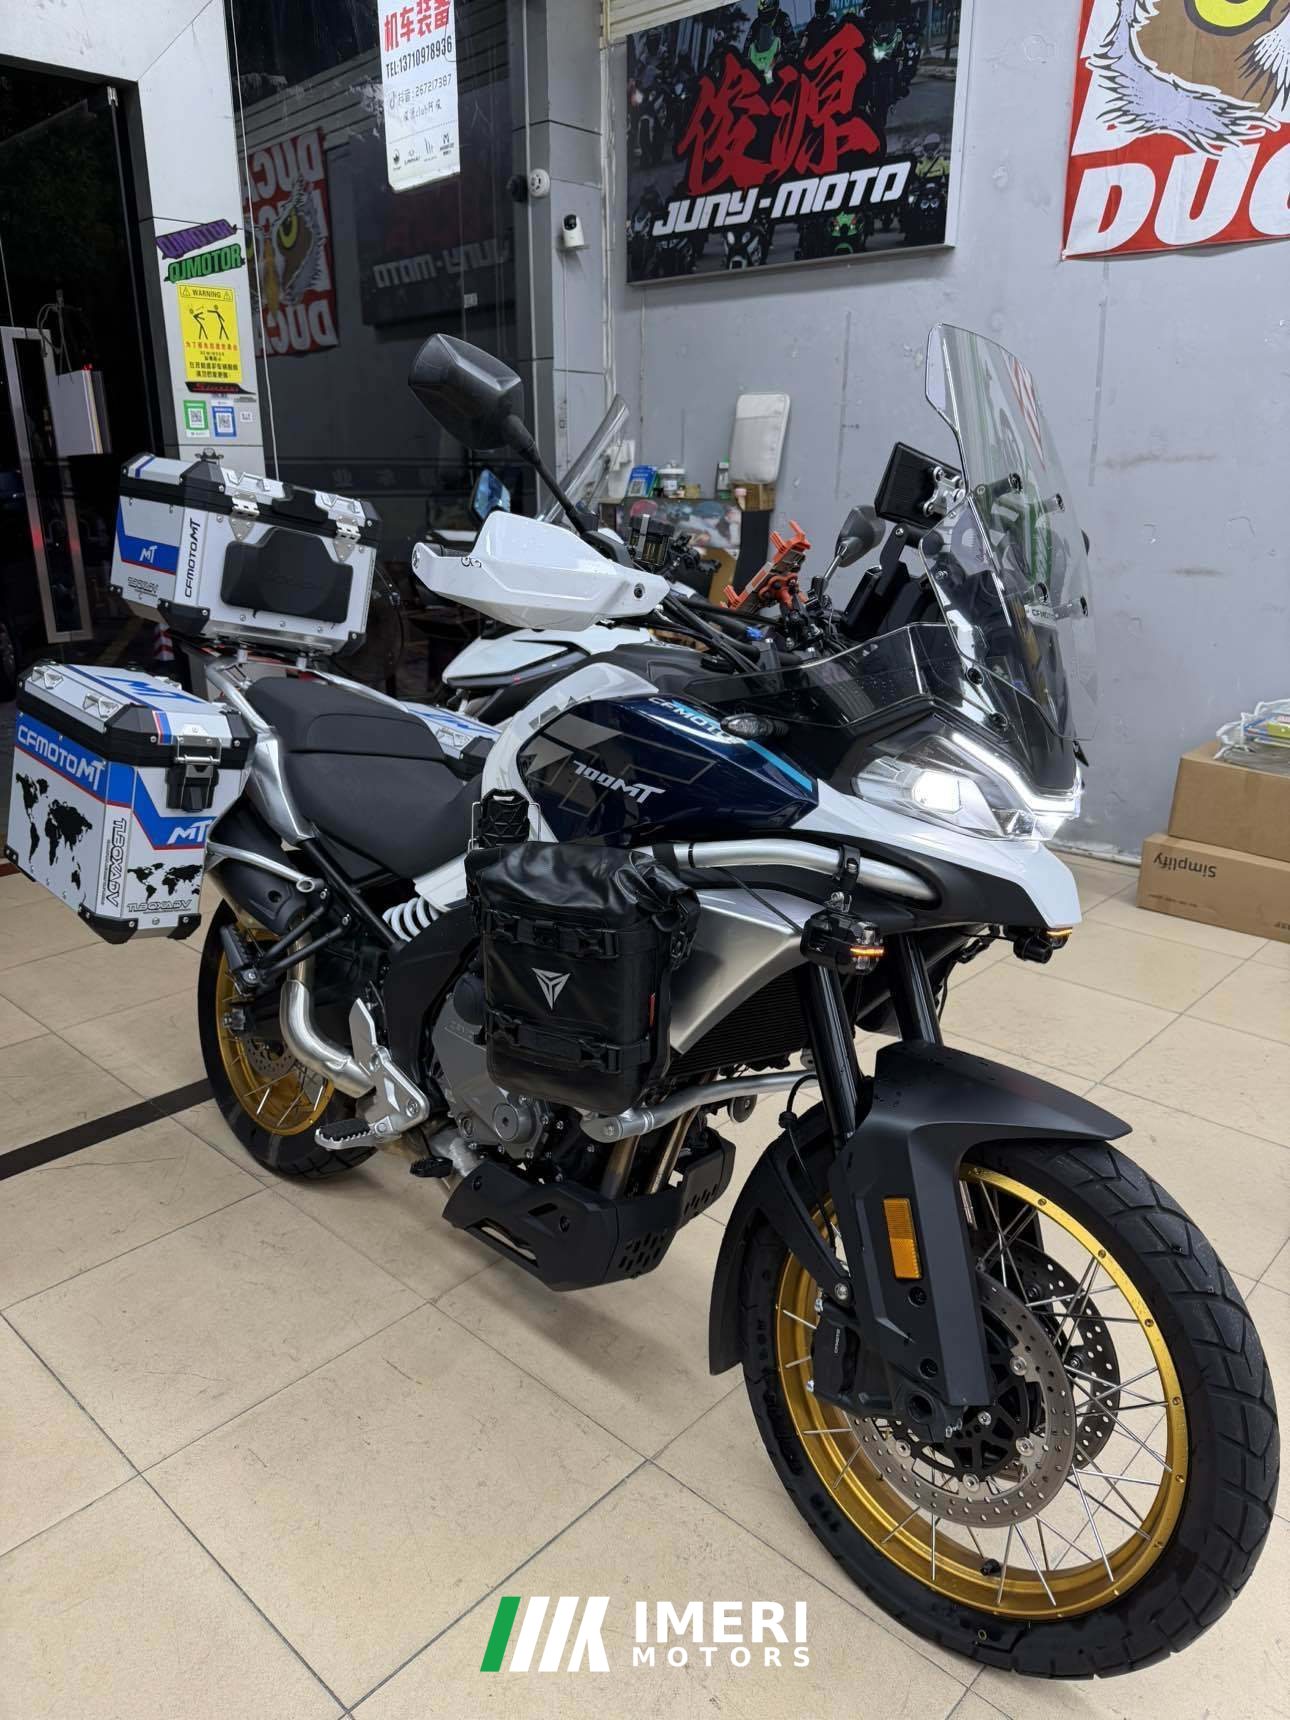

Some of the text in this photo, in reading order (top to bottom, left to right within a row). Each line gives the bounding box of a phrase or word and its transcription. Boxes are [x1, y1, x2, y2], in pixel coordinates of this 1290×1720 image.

[384, 0, 451, 52] 机车装备
[386, 35, 453, 78] TEL:13710978936
[677, 23, 880, 196] 俊源
[169, 245, 242, 282] QJMOTOR
[191, 288, 222, 299] WARNING
[139, 545, 158, 564] MT
[573, 760, 666, 804] 700MT
[167, 819, 211, 845] MT
[1153, 852, 1217, 879] Simplify
